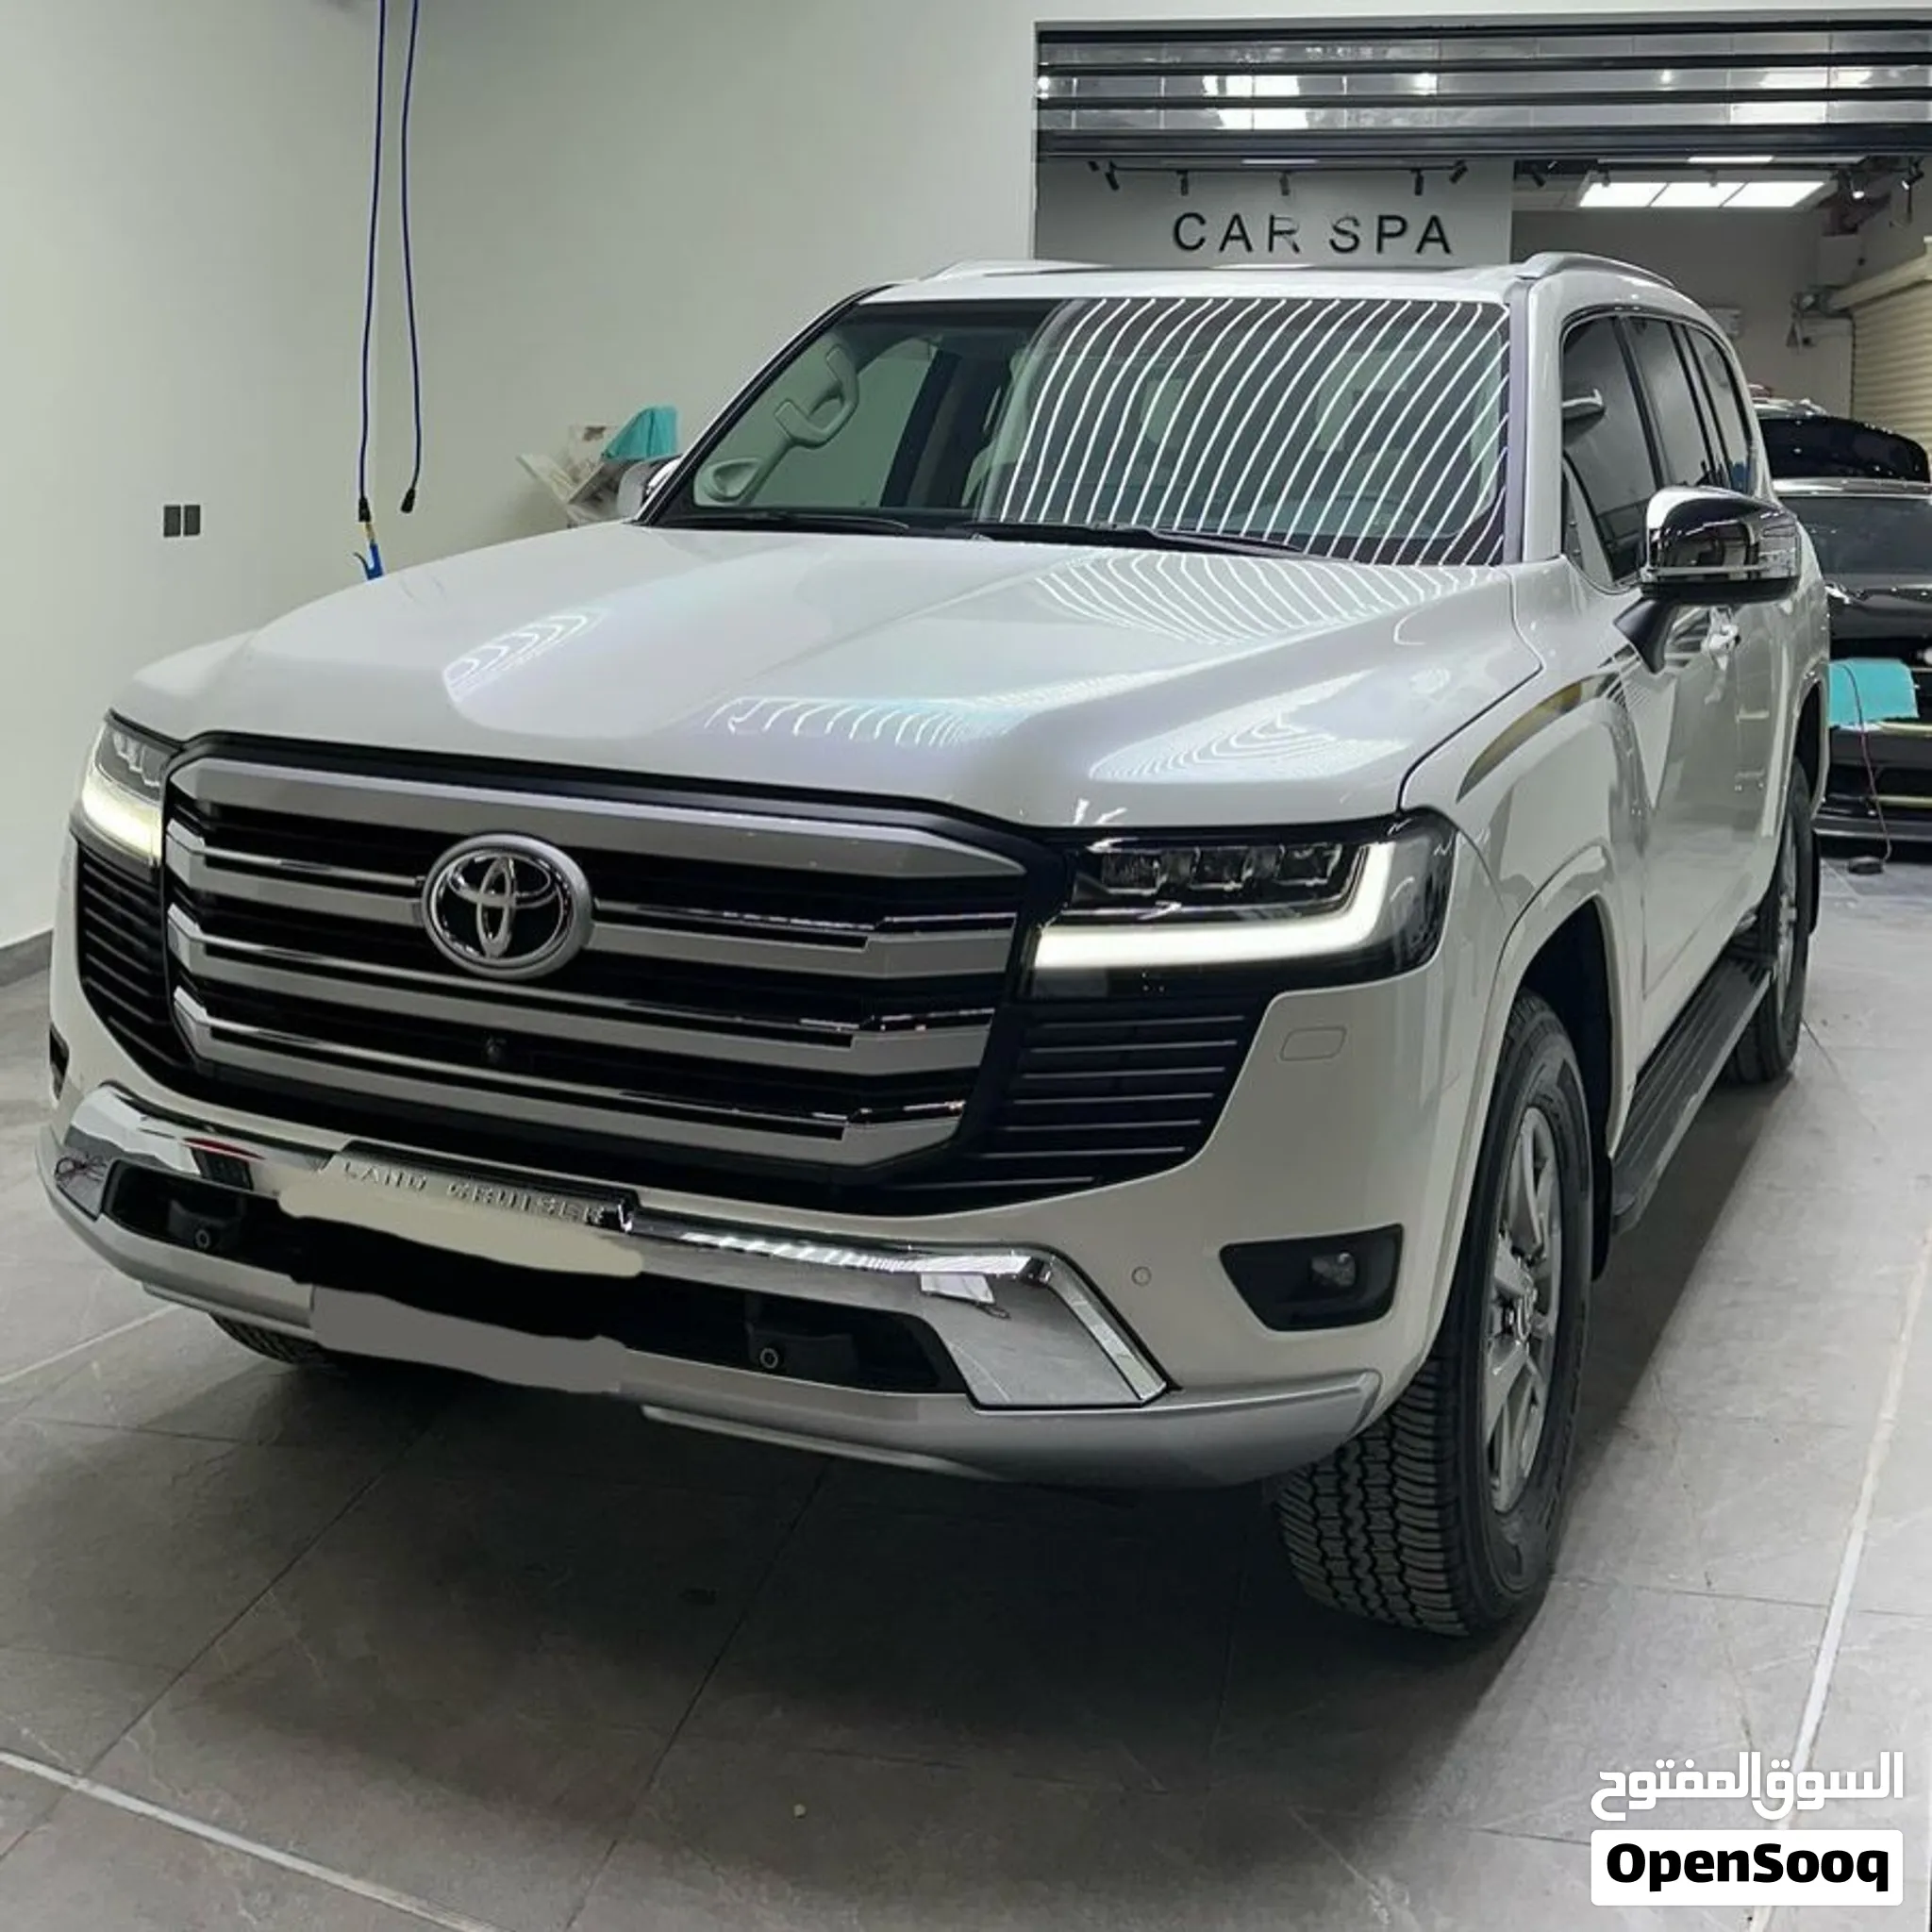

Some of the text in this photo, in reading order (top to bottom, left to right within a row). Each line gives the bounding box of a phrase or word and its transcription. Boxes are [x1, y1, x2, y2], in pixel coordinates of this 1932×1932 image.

[1173, 212, 1452, 254] CAR SPA
[343, 1161, 605, 1224] LAND CRUISER
